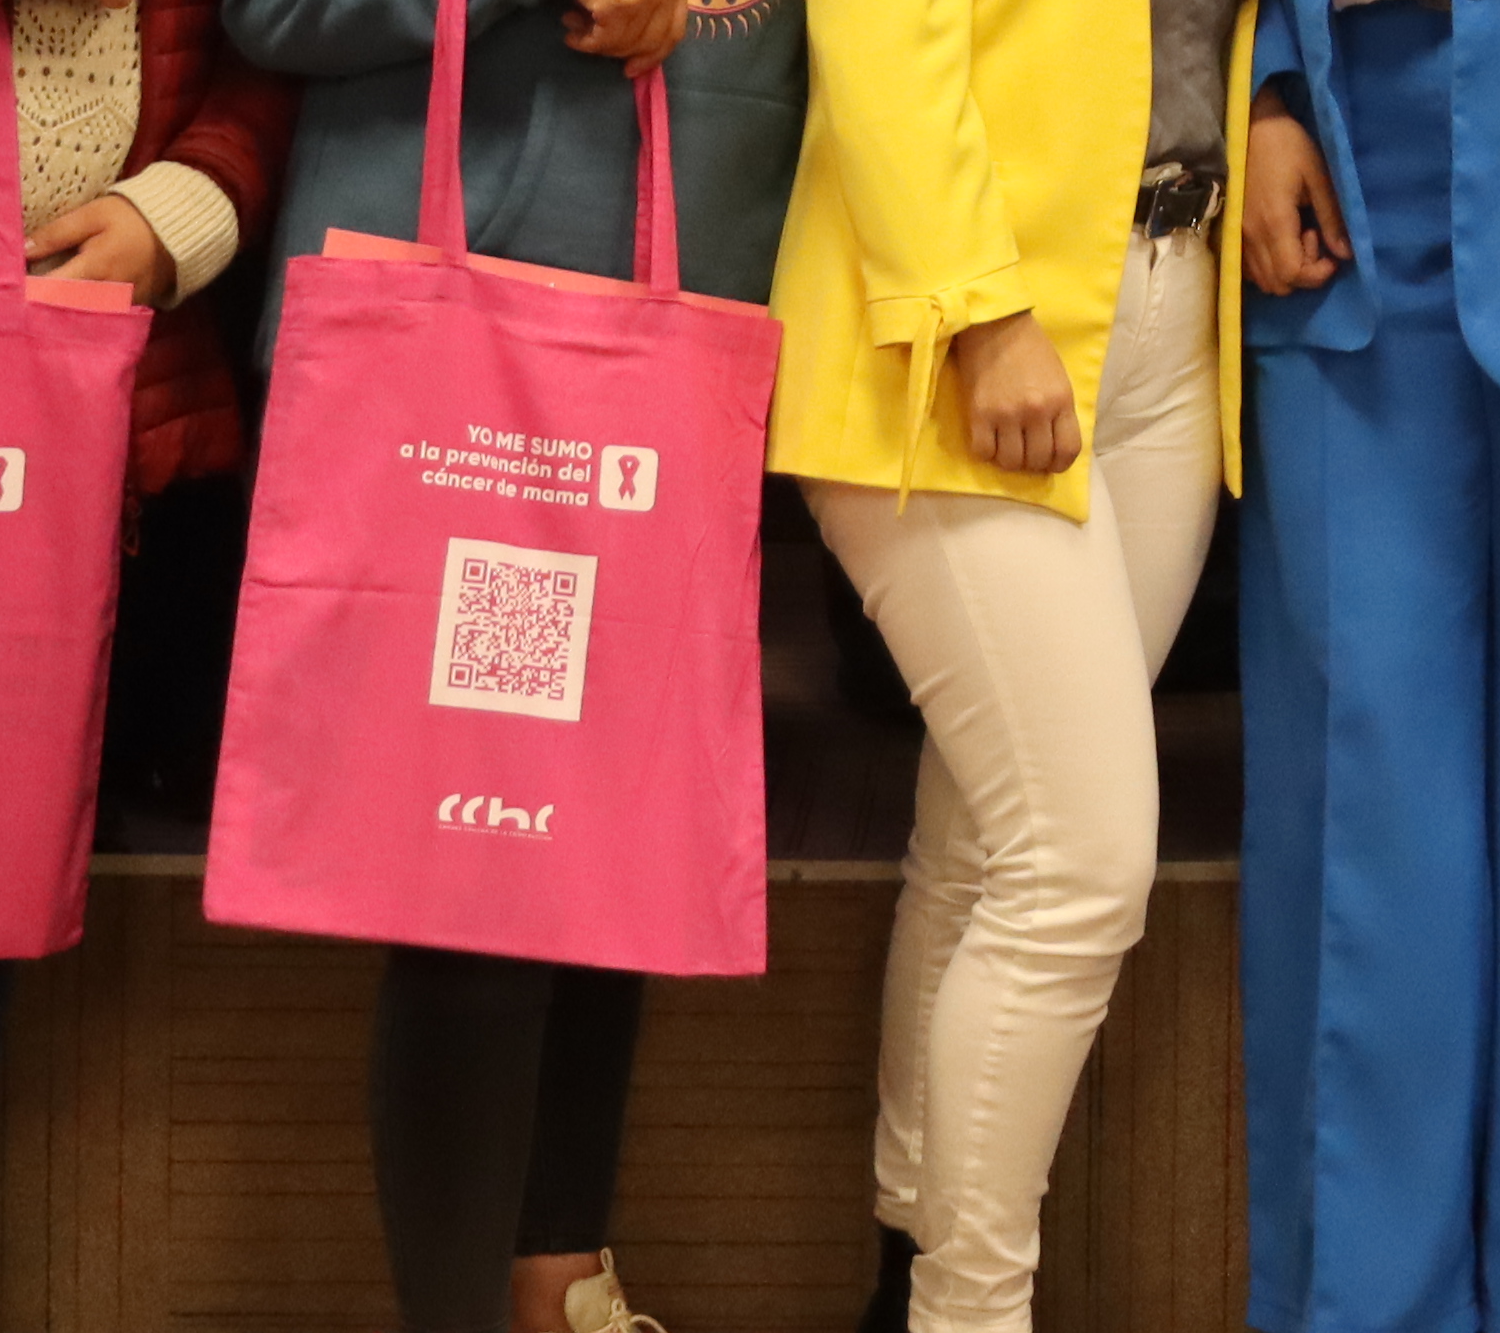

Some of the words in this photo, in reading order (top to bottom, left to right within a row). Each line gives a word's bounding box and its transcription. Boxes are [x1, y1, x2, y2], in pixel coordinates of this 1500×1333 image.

[400, 443, 414, 458] a
[420, 440, 440, 460] la
[445, 448, 552, 478] prevención
[557, 463, 591, 482] del
[467, 424, 492, 445] YO
[496, 431, 526, 451] ME
[530, 437, 592, 460] SUMO
[422, 468, 493, 492] cáncer
[497, 479, 517, 498] de
[522, 486, 589, 506] mama
